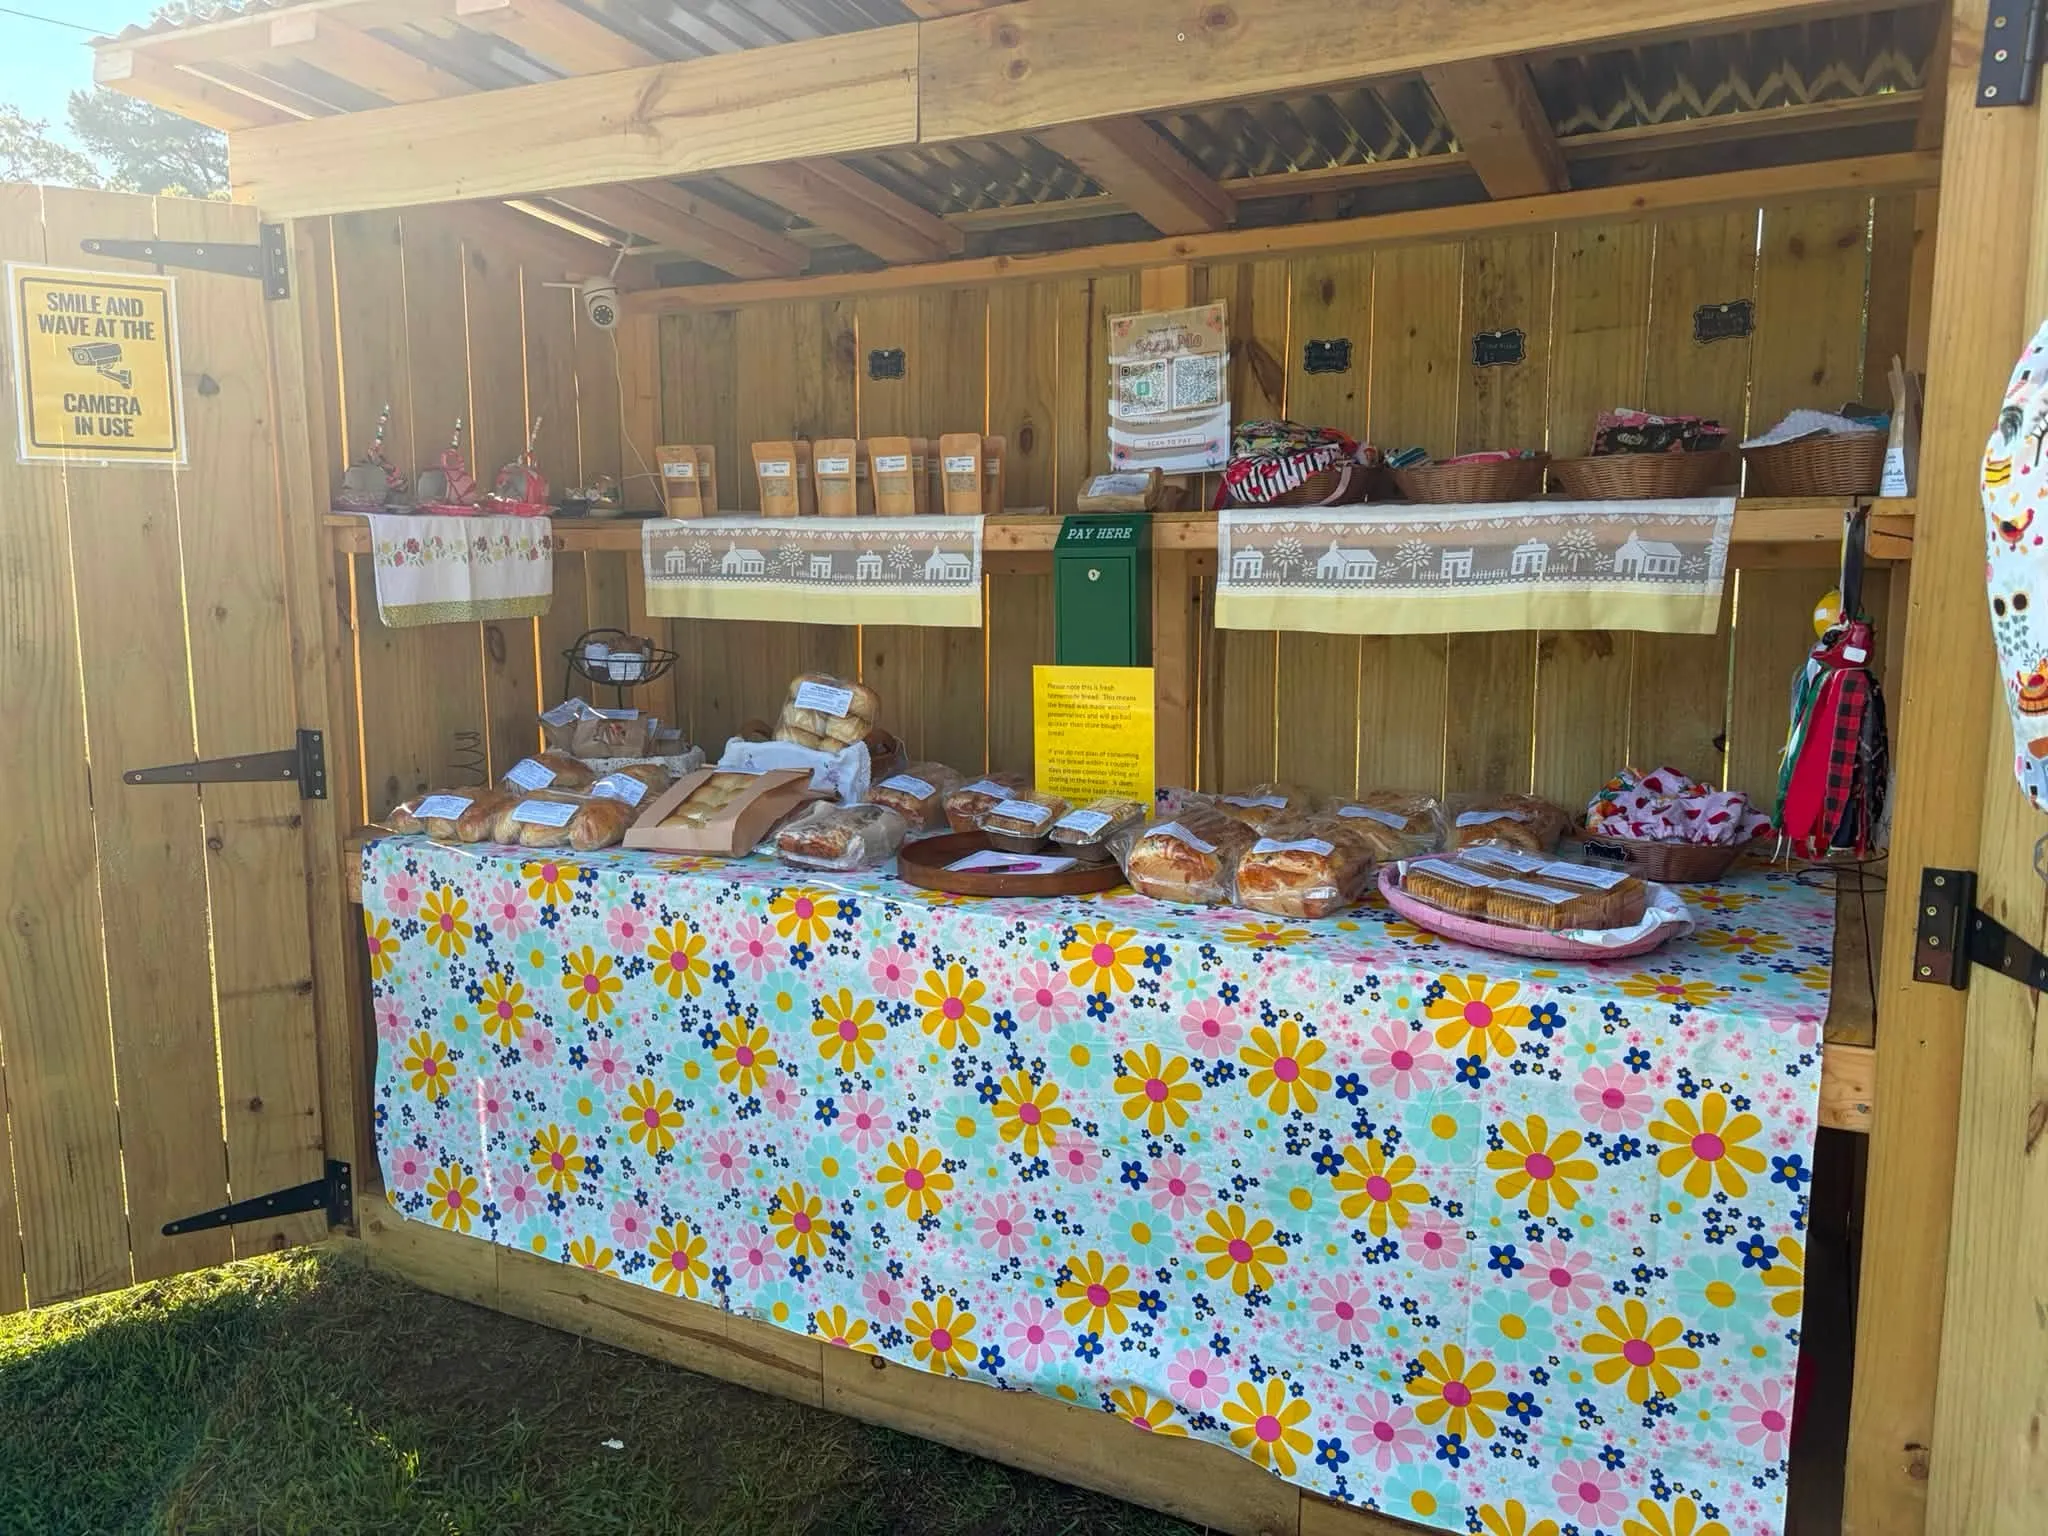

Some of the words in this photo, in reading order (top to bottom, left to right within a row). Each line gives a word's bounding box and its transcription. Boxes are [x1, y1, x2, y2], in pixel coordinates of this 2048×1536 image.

[47, 292, 101, 314] SMILE
[106, 296, 144, 317] AND
[38, 313, 90, 336] WAVE
[95, 317, 117, 338] AT
[120, 319, 156, 341] THE
[63, 393, 142, 416] CAMERA
[74, 416, 93, 436] IN
[98, 418, 134, 437] USE
[1066, 528, 1095, 540] PAY
[1096, 527, 1133, 539] HERE
[1099, 683, 1115, 691] fresh
[1100, 722, 1122, 730] bought
[1048, 776, 1068, 784] storing
[1059, 785, 1081, 794] change
